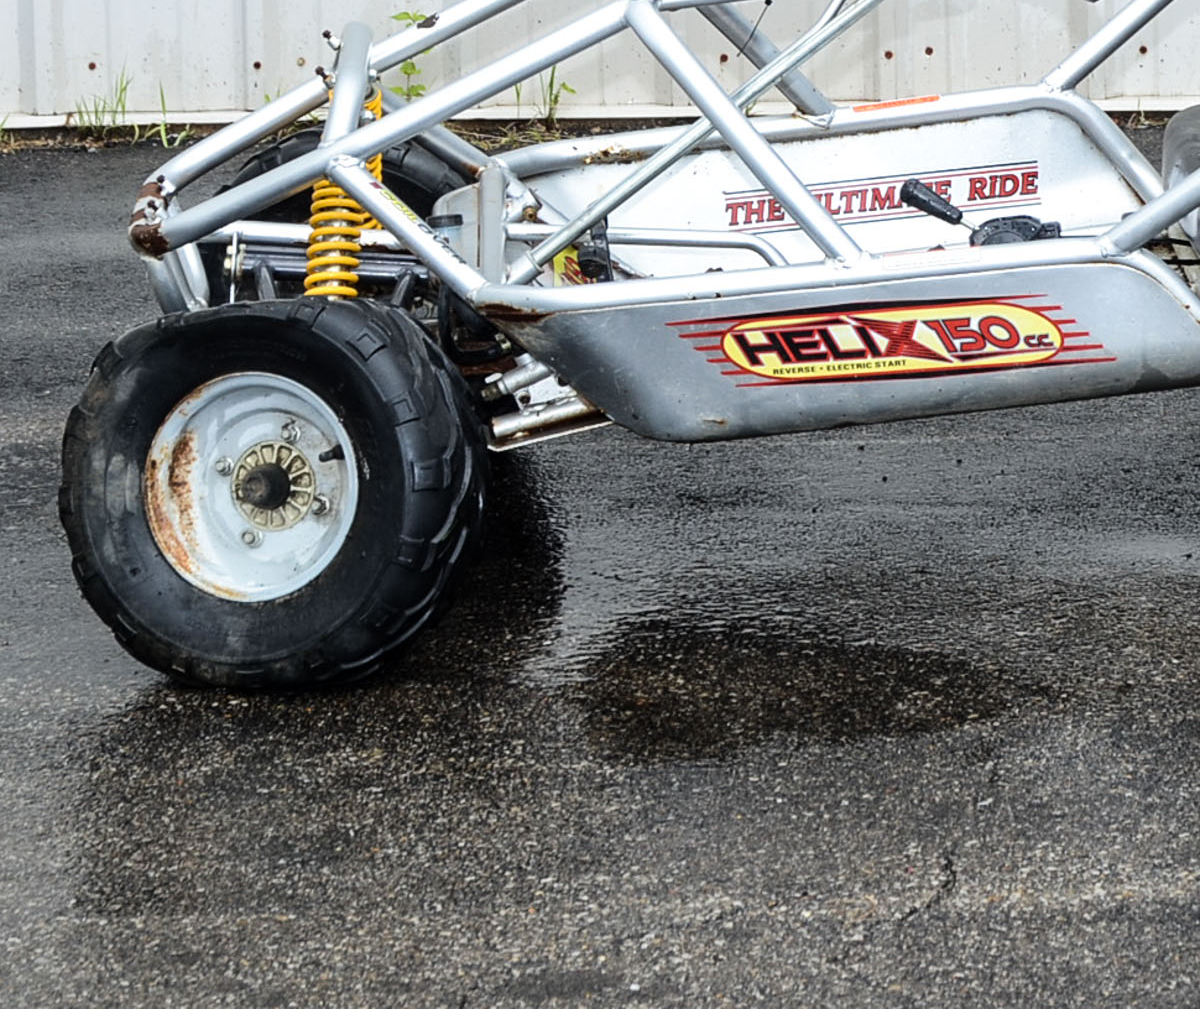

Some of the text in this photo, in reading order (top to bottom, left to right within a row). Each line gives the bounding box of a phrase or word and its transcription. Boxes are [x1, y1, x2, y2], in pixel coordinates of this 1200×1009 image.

[725, 199, 785, 227] THE
[967, 171, 1039, 201] RIDE
[732, 317, 944, 367] HELIX
[928, 316, 1020, 353] 150
[772, 358, 907, 376] REVERSE ELECTRIC START
